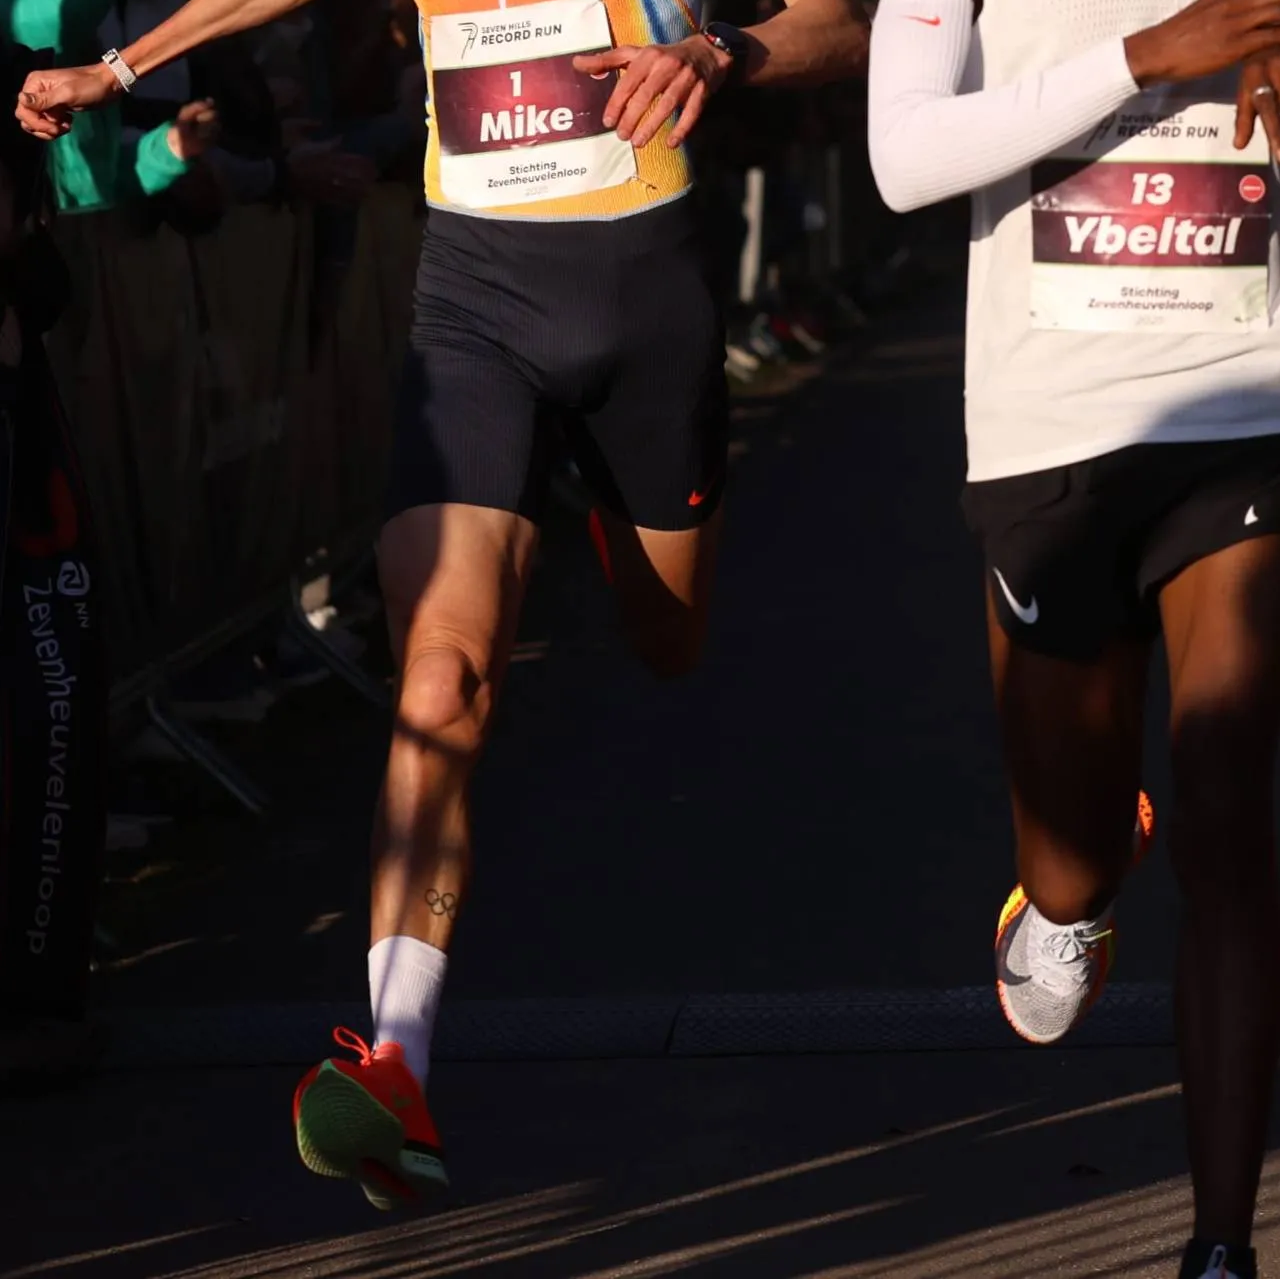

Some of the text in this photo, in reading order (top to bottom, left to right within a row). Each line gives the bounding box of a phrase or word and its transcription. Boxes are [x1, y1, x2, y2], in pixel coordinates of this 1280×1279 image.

[481, 20, 532, 34] SEVEN HILLS
[481, 23, 562, 46] RECORD RUN
[509, 71, 523, 97] 1
[480, 103, 574, 143] Mike
[1117, 125, 1219, 138] RECORD RUN
[487, 166, 588, 189] Zevenheuvelenloop
[509, 161, 557, 175] Stichting
[1131, 172, 1175, 206] 13
[1064, 215, 1243, 256] Ybeltal
[1120, 286, 1180, 300] Stichting
[1087, 297, 1215, 313] Zevenheuvelenloop
[22, 576, 78, 955] Zevenheuvelenloop
